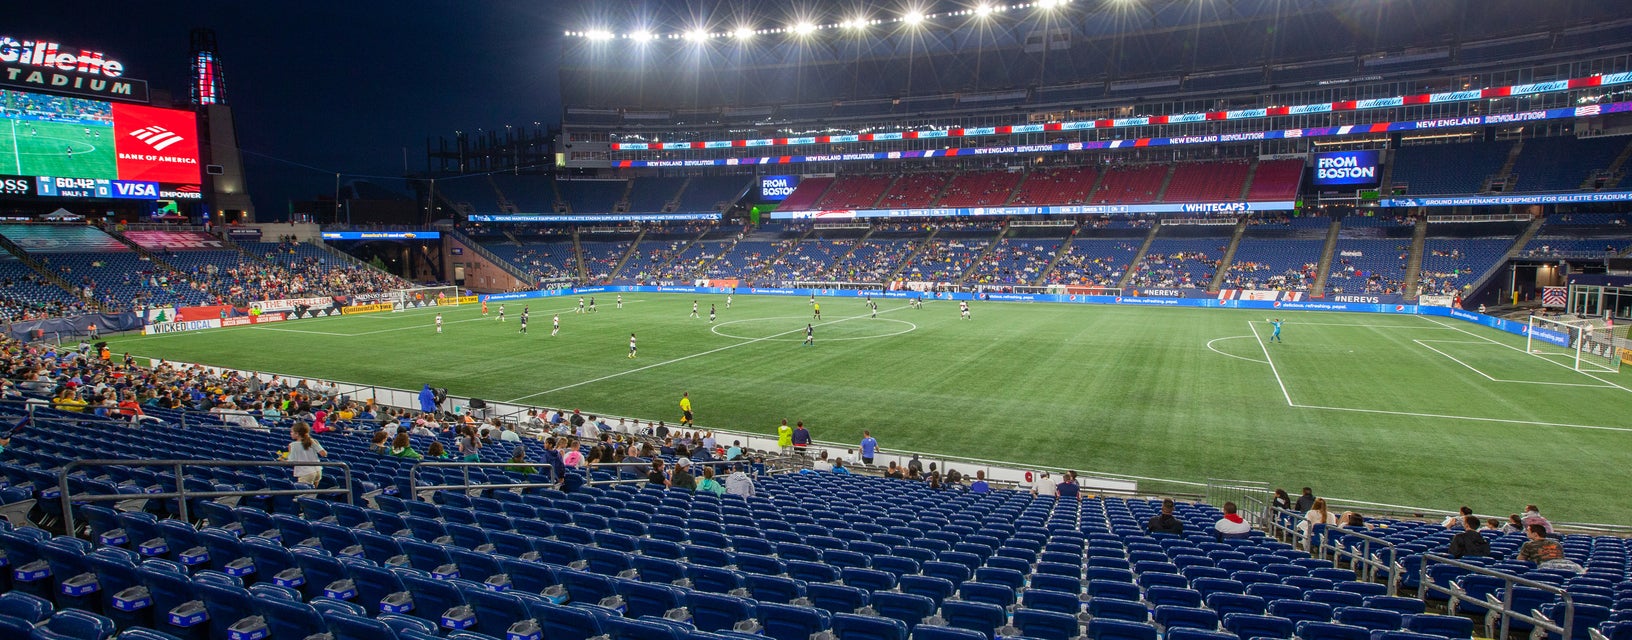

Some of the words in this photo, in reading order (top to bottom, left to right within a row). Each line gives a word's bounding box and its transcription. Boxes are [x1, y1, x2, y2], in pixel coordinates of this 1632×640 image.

[0, 37, 124, 77] Gillette
[1416, 120, 1437, 128] NEW
[1438, 117, 1480, 127] ENGLAND
[1485, 111, 1546, 124] REVOLUTION
[1186, 135, 1218, 144] ENGLAND
[1220, 132, 1264, 142] REVOLUTION
[159, 156, 196, 164] AMERICA
[1318, 156, 1358, 168] FROM
[1318, 166, 1374, 179] BOSTON
[44, 184, 49, 193] 1
[56, 178, 95, 189] 60:42
[763, 179, 787, 188] FROM
[100, 186, 107, 195] 0
[113, 182, 156, 196] VISA
[1186, 203, 1245, 212] WHITECAPS
[1144, 288, 1179, 297] #NEREVS
[264, 300, 281, 308] THE
[1335, 295, 1379, 304] #NEREVS
[344, 302, 374, 313] Continental
